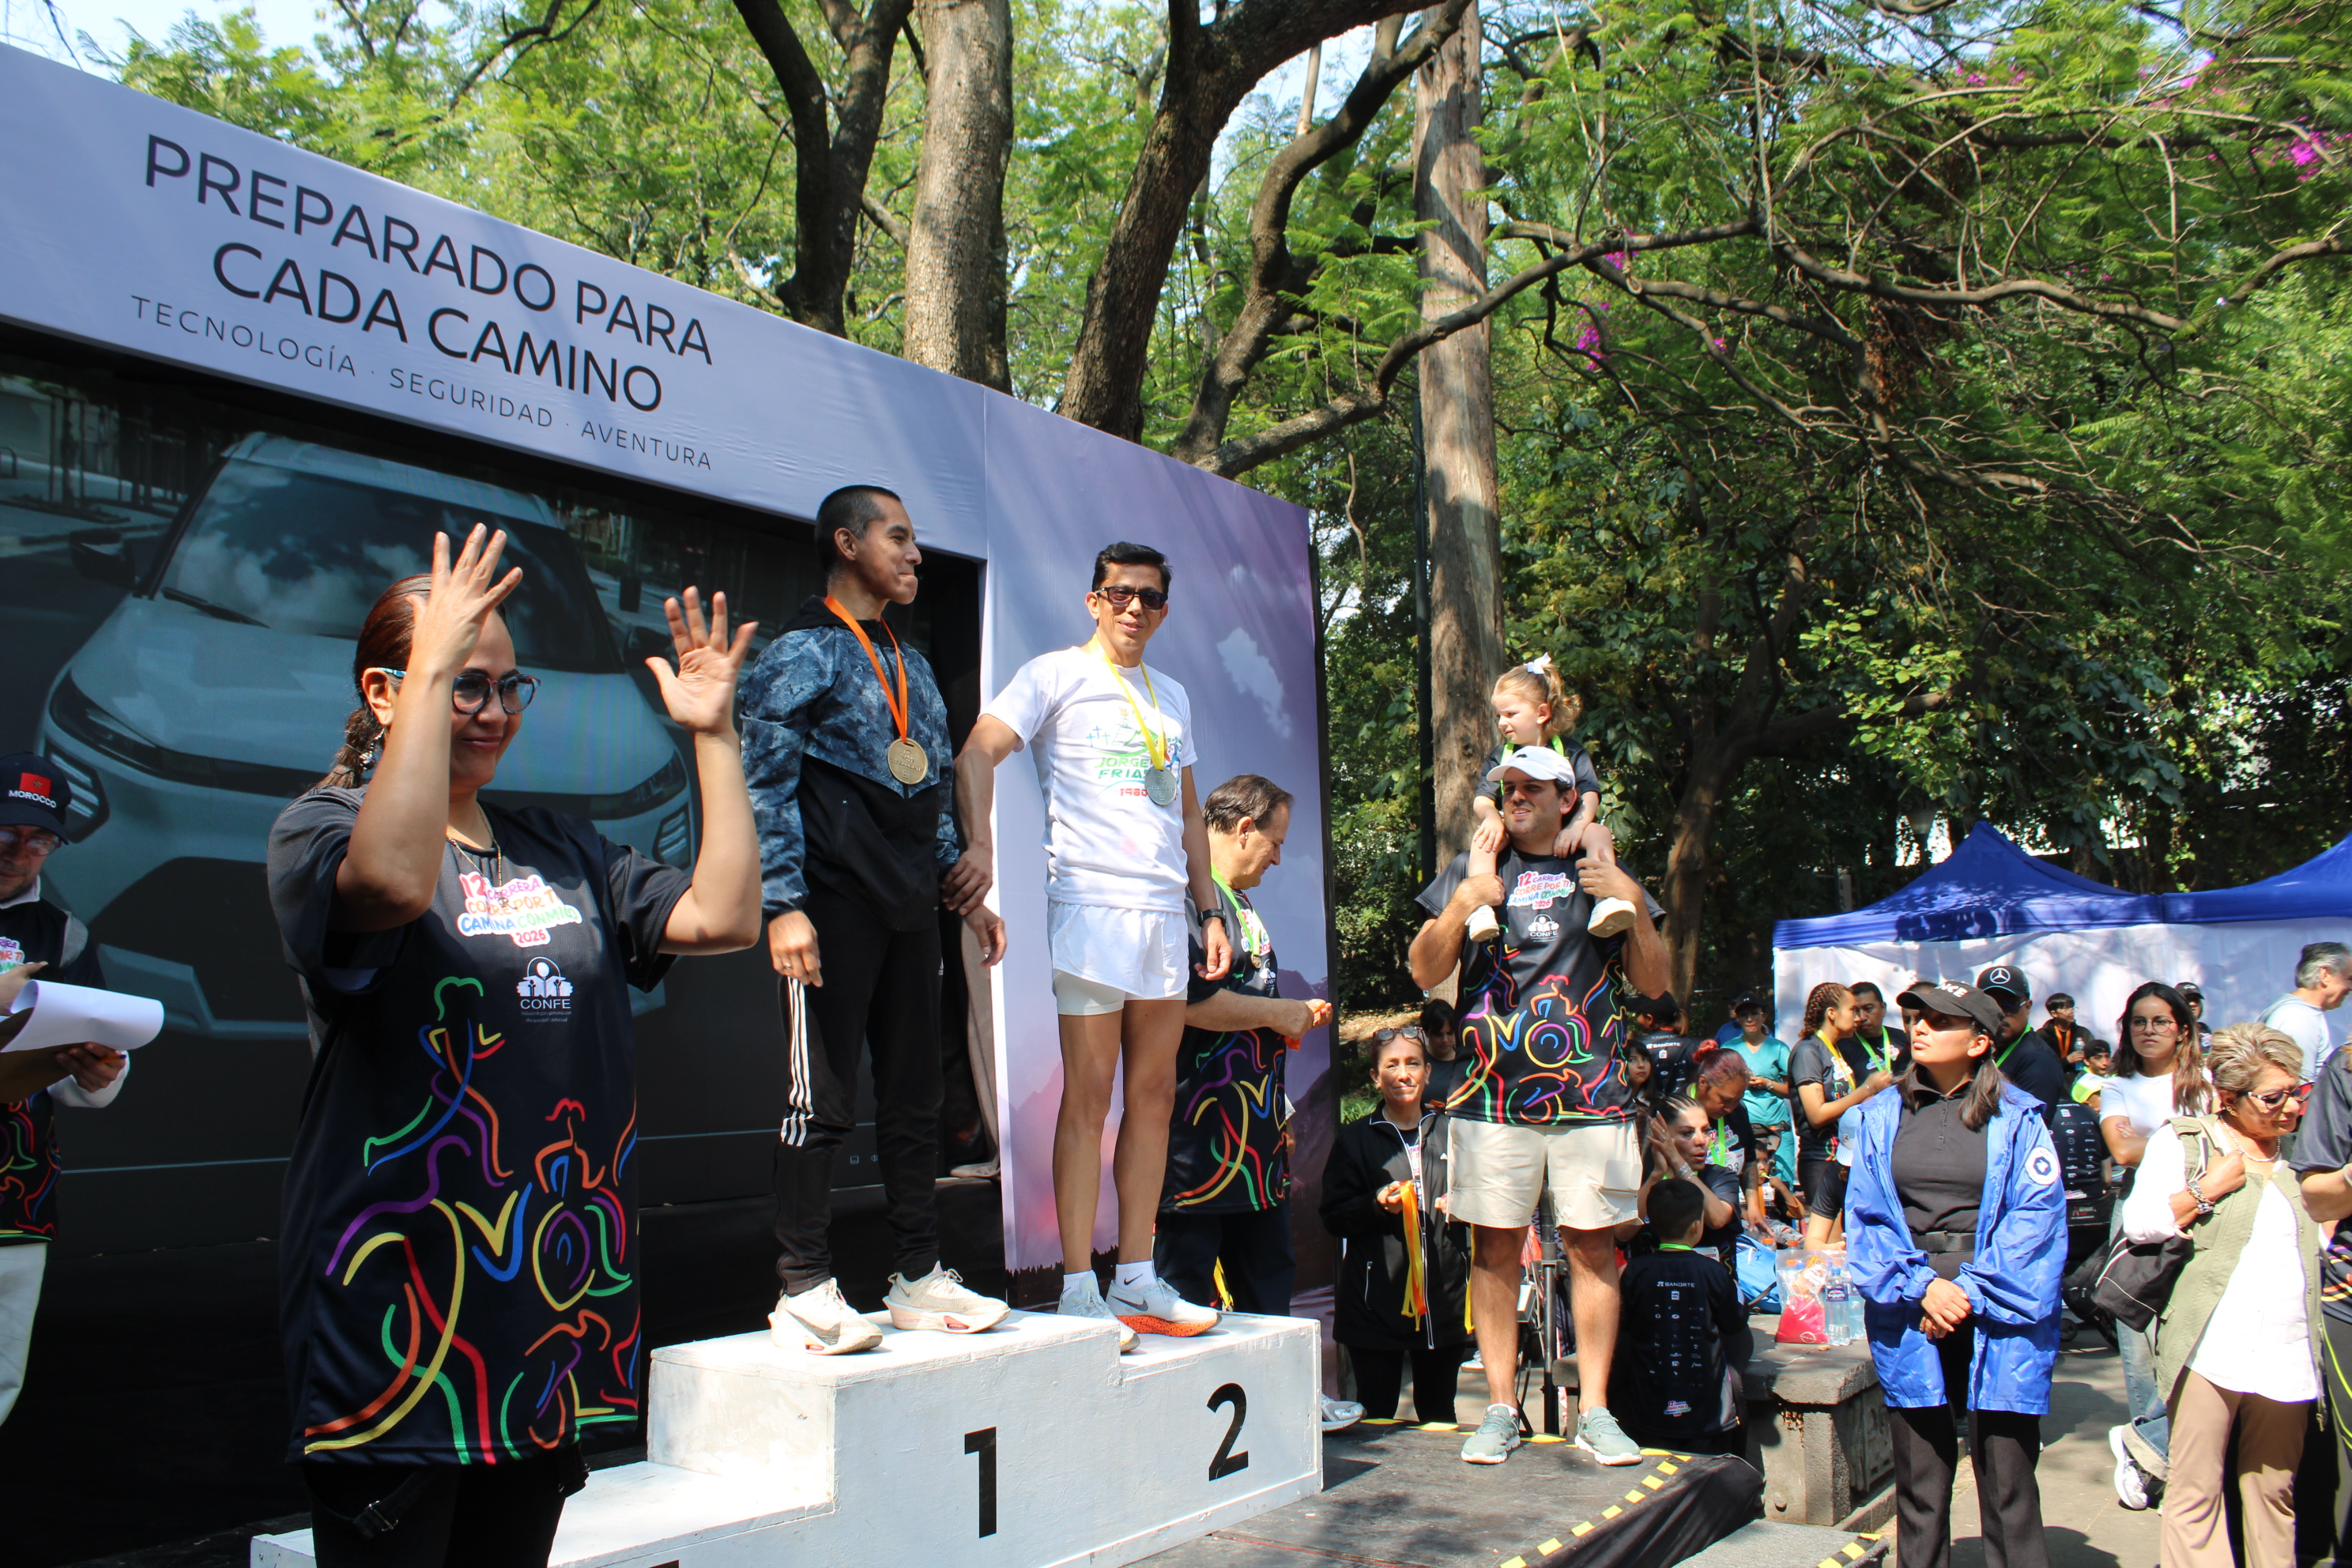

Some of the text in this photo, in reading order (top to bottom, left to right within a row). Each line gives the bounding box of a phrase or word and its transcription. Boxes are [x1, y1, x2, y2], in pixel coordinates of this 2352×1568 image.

[146, 134, 713, 365] PREPARADO PARA
[213, 242, 662, 413] CADA CAMINO
[131, 295, 713, 472] TECNOLOGÍA SEGURIDAD AVENTURA
[1094, 757, 1149, 768] JORGE
[8, 790, 57, 808] MOROCCO
[1532, 873, 1564, 883] CARRERA
[487, 877, 541, 900] CARRERA
[1515, 883, 1543, 895] CORRE
[1544, 881, 1561, 890] POR
[514, 895, 545, 910] POR
[461, 917, 518, 933] CAMINA
[515, 929, 546, 944] 2026
[520, 998, 571, 1009] CONFE
[1206, 1381, 1249, 1482] 2
[963, 1426, 997, 1540] 1
